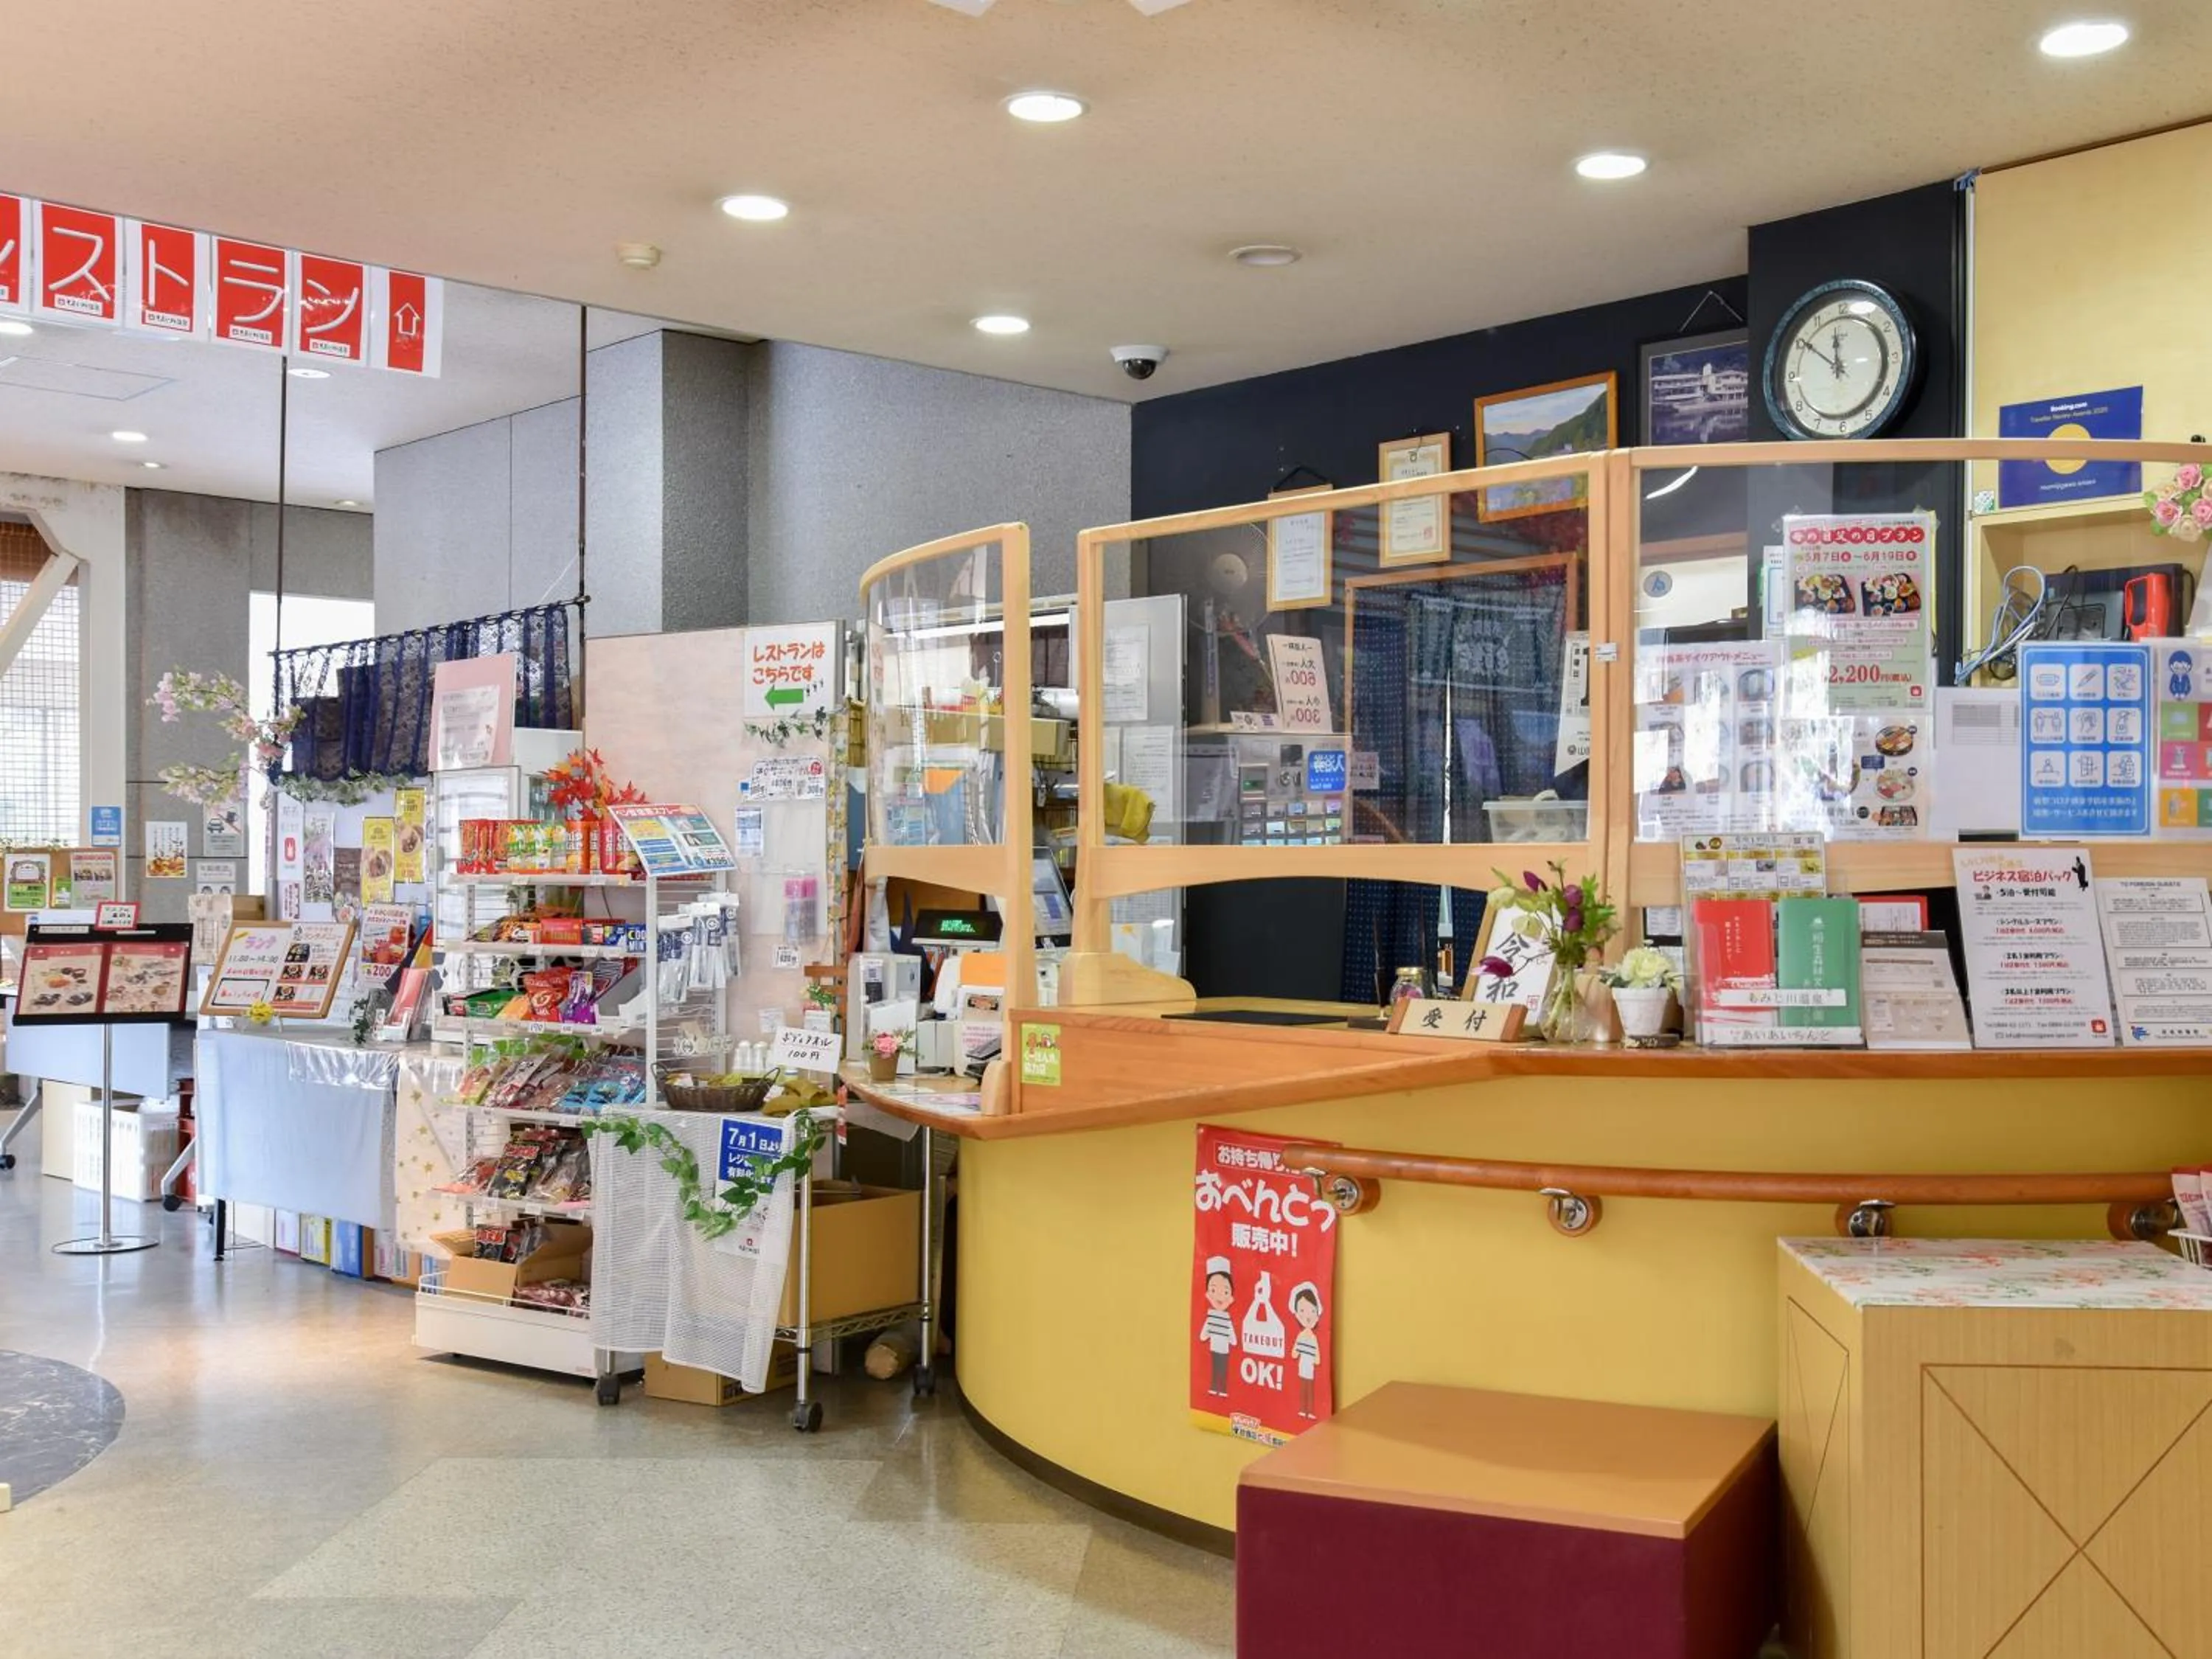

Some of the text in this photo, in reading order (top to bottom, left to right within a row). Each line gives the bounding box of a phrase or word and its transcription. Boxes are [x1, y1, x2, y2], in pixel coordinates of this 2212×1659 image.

[1884, 321, 1892, 333] 2
[1892, 351, 1899, 364] 3
[1882, 386, 1890, 397] 4
[1796, 400, 1803, 411] 8
[1865, 409, 1872, 421] 5
[1814, 419, 1821, 429] 7
[1840, 421, 1846, 433] 6
[754, 640, 825, 663] レストランは
[753, 664, 815, 685] こちらです
[1972, 870, 2071, 883] ビジネス宿泊パック
[1750, 992, 1823, 1004] もみじ川温泉
[1421, 1006, 1488, 1032] 受付
[788, 1049, 820, 1061] 100円
[728, 1127, 782, 1152] 7月1日より
[1231, 1222, 1298, 1257] 販売中!
[1243, 1332, 1283, 1349] TAKEOUT
[1240, 1357, 1284, 1391] OK!
